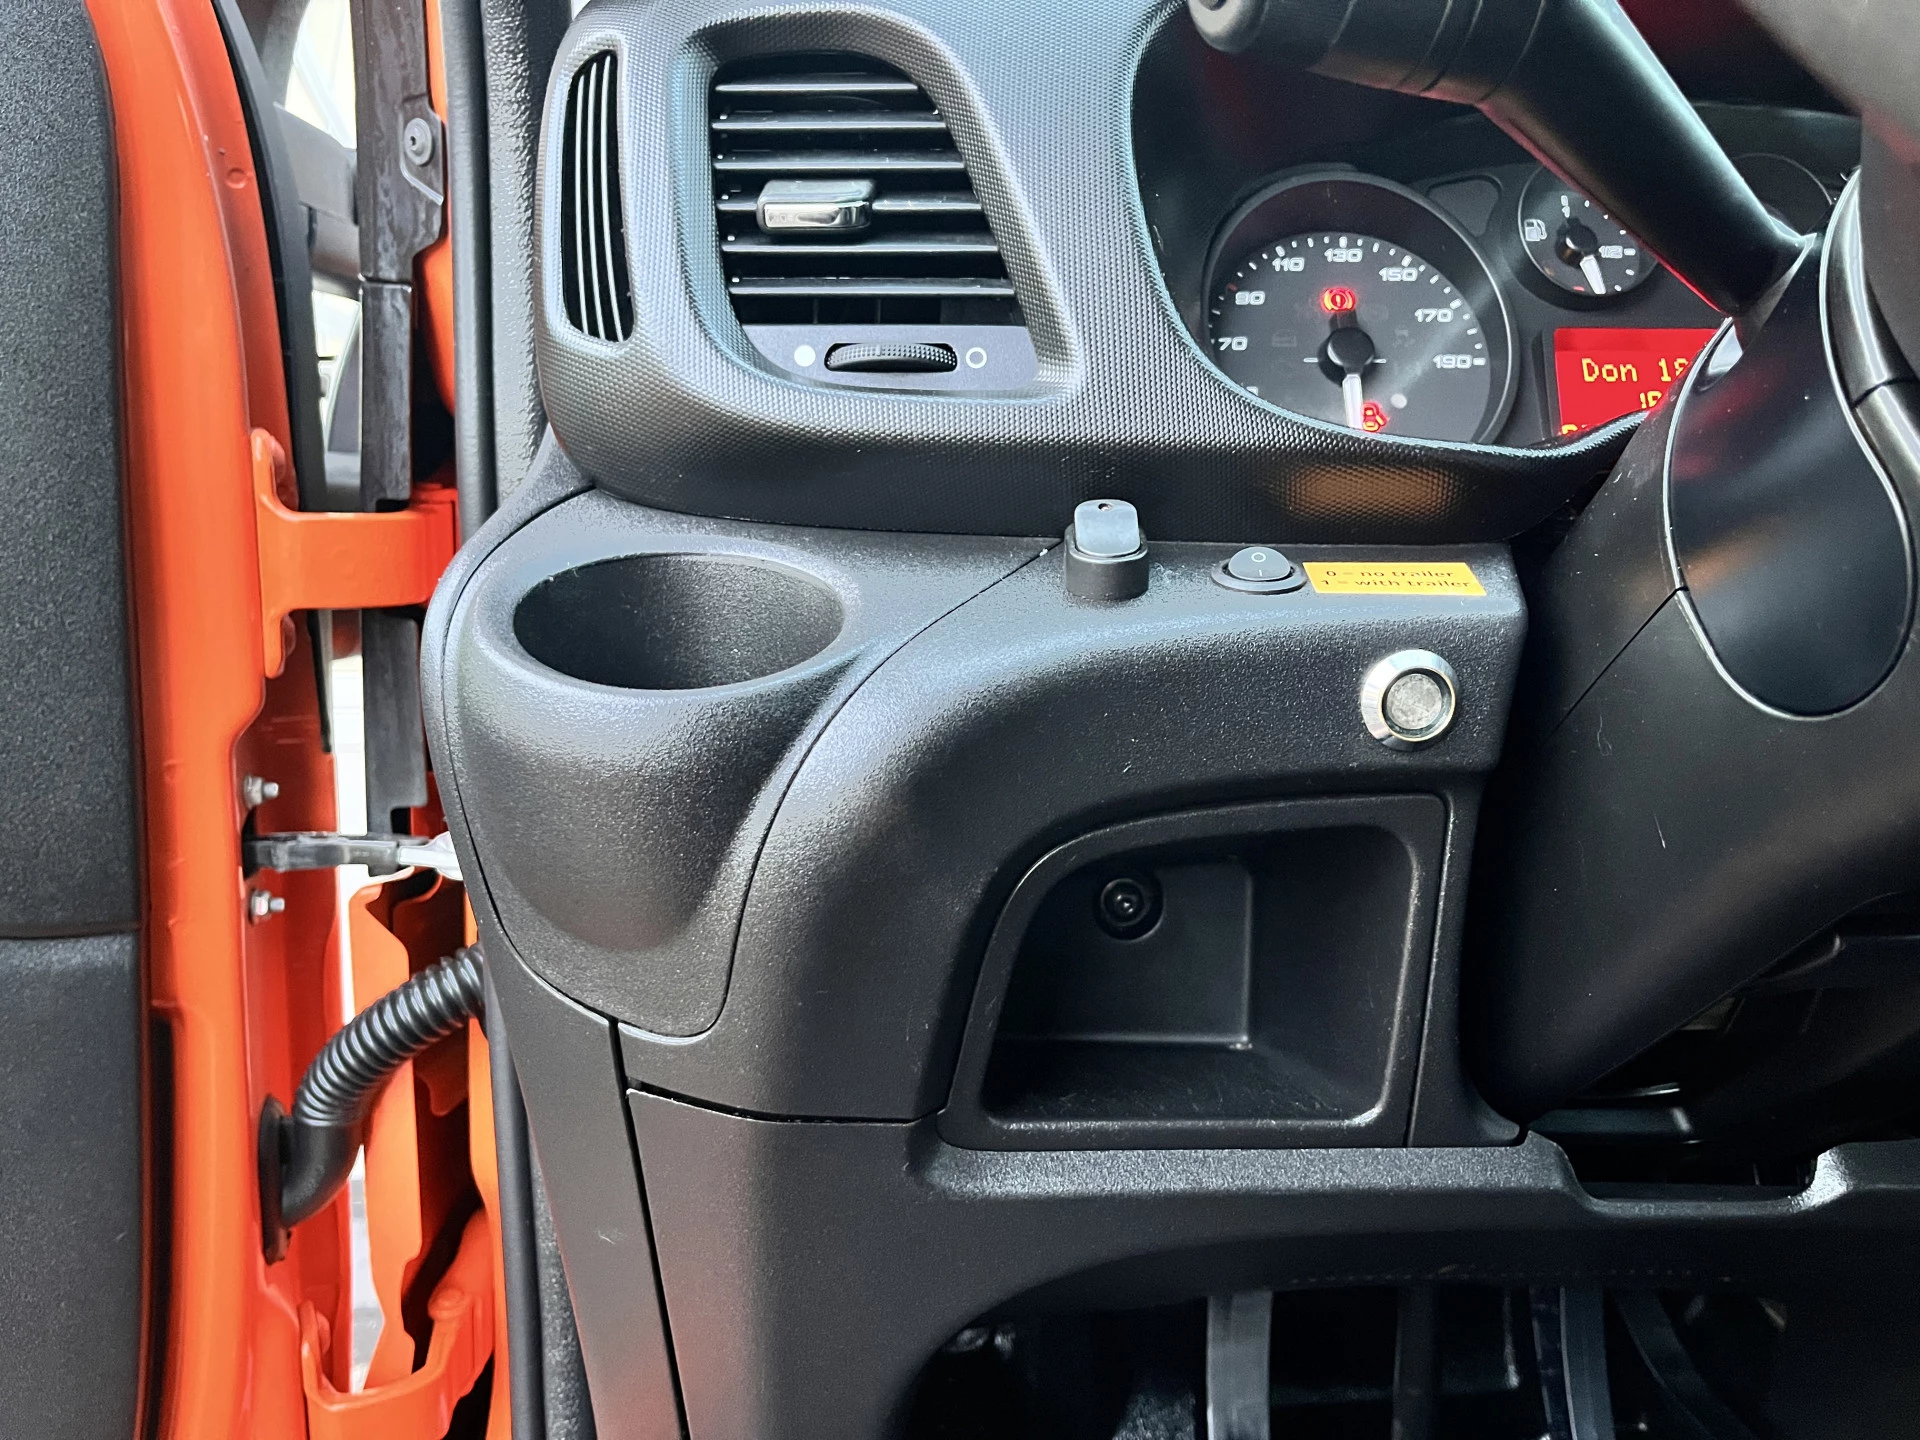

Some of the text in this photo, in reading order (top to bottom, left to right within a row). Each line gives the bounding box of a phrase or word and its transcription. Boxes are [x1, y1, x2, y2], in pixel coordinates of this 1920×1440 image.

[1324, 248, 1363, 263] 130
[1272, 257, 1305, 272] 110
[1378, 267, 1418, 282] 150
[1414, 308, 1454, 323] 170
[1218, 336, 1248, 351] 70
[1433, 354, 1473, 369] 190
[1581, 358, 1638, 382] Don
[1392, 570, 1454, 578] trailer
[1407, 580, 1471, 588] trailer
